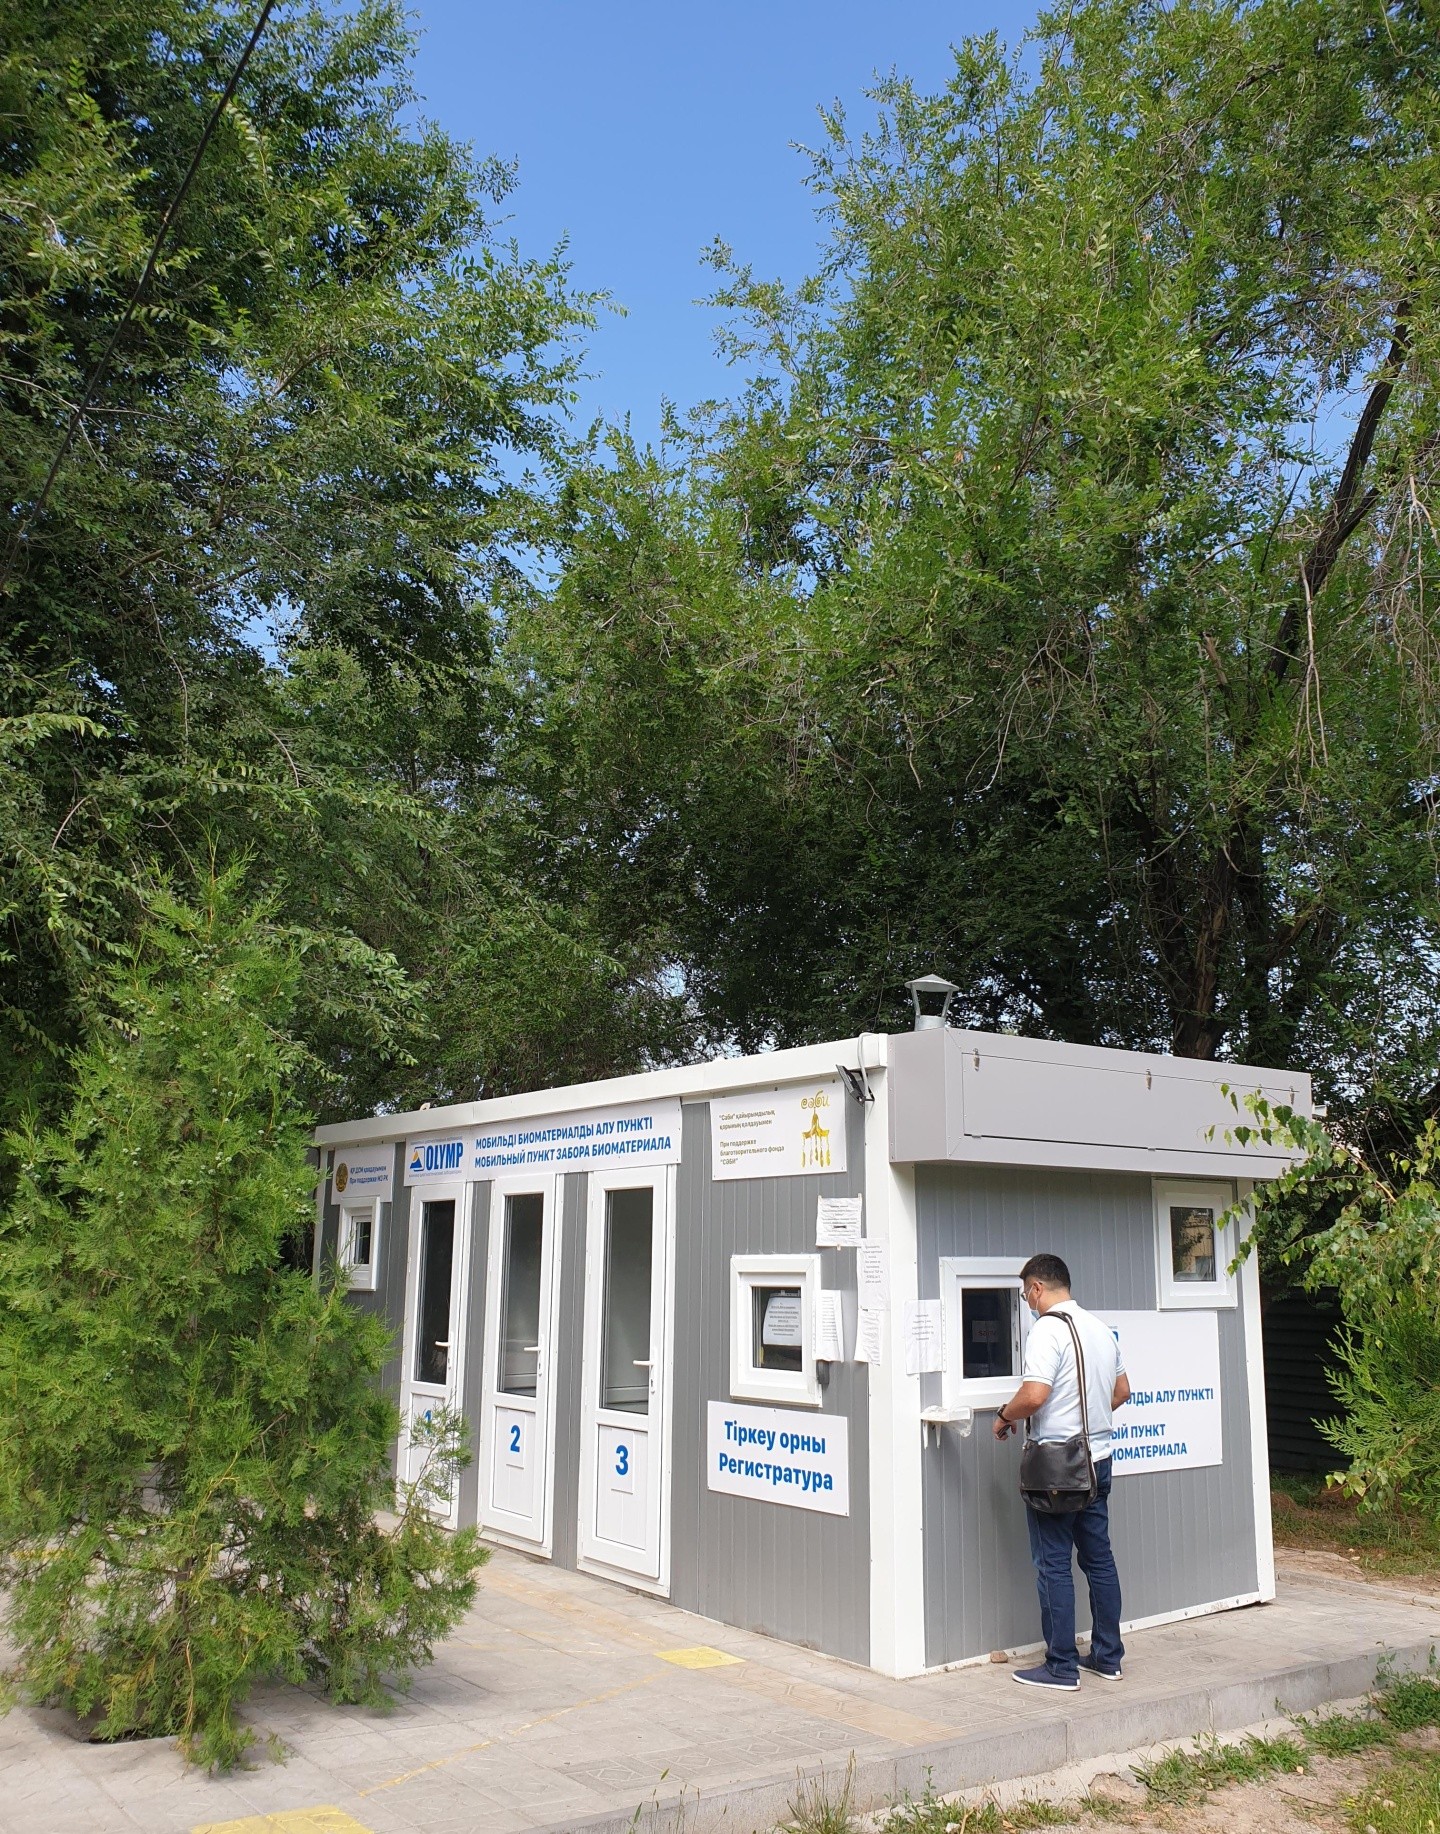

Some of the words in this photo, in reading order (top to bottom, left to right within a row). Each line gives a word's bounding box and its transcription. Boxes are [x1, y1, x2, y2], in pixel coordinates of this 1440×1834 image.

[476, 1133, 516, 1150] МОБИЛЬДІ
[518, 1124, 594, 1145] БИОМАТЕРИАЛДЫ
[596, 1121, 615, 1135] АЛУ
[617, 1116, 653, 1133] ПУНКТІ
[730, 1139, 757, 1147] поддержке
[426, 1142, 463, 1170] OLYMP
[474, 1149, 525, 1168] МОБИЛЬНЫЙ
[527, 1149, 555, 1163] ПУНКТ
[556, 1145, 590, 1160] ЗАБОРА
[592, 1136, 671, 1157] БИОМАТЕРИАЛА
[720, 1147, 767, 1156] благотворительного
[768, 1145, 785, 1153] фонда
[1156, 1389, 1176, 1403] АЛУ
[1178, 1388, 1214, 1402] ПУНКТІ
[510, 1425, 521, 1453] 2
[724, 1420, 776, 1451] Тіркеу
[780, 1431, 826, 1454] орны
[1131, 1423, 1166, 1438] ПУНКТ
[615, 1444, 629, 1476] 3
[1111, 1442, 1188, 1461] ИОМАТЕРИАЛА
[719, 1452, 833, 1493] Регистратура
